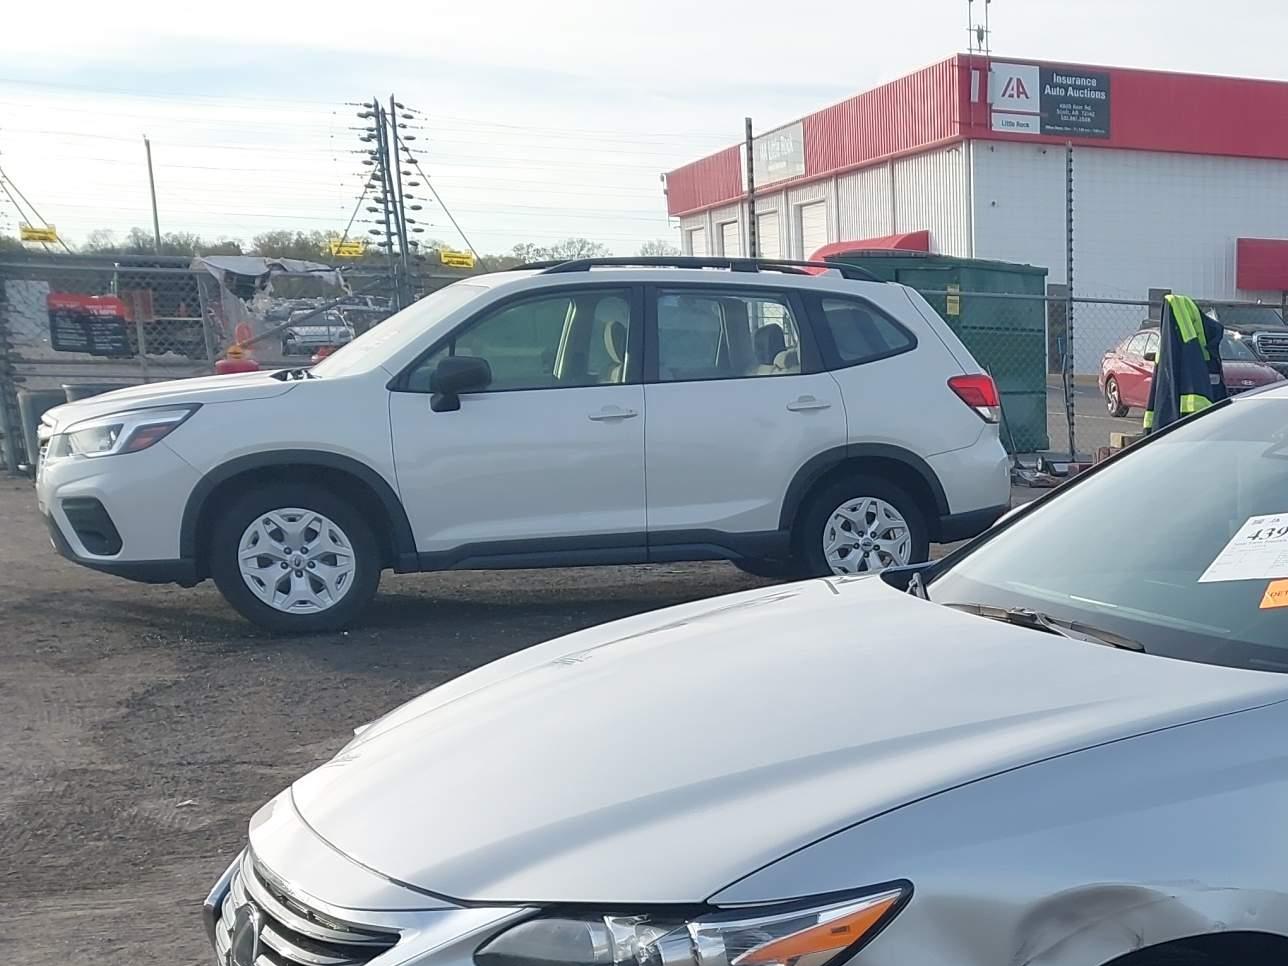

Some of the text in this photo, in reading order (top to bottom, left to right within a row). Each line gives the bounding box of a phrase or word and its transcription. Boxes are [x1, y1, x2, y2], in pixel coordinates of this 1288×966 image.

[1053, 72, 1097, 86] Insurance
[1044, 85, 1106, 99] Auto Auctions
[1001, 119, 1015, 128] Little
